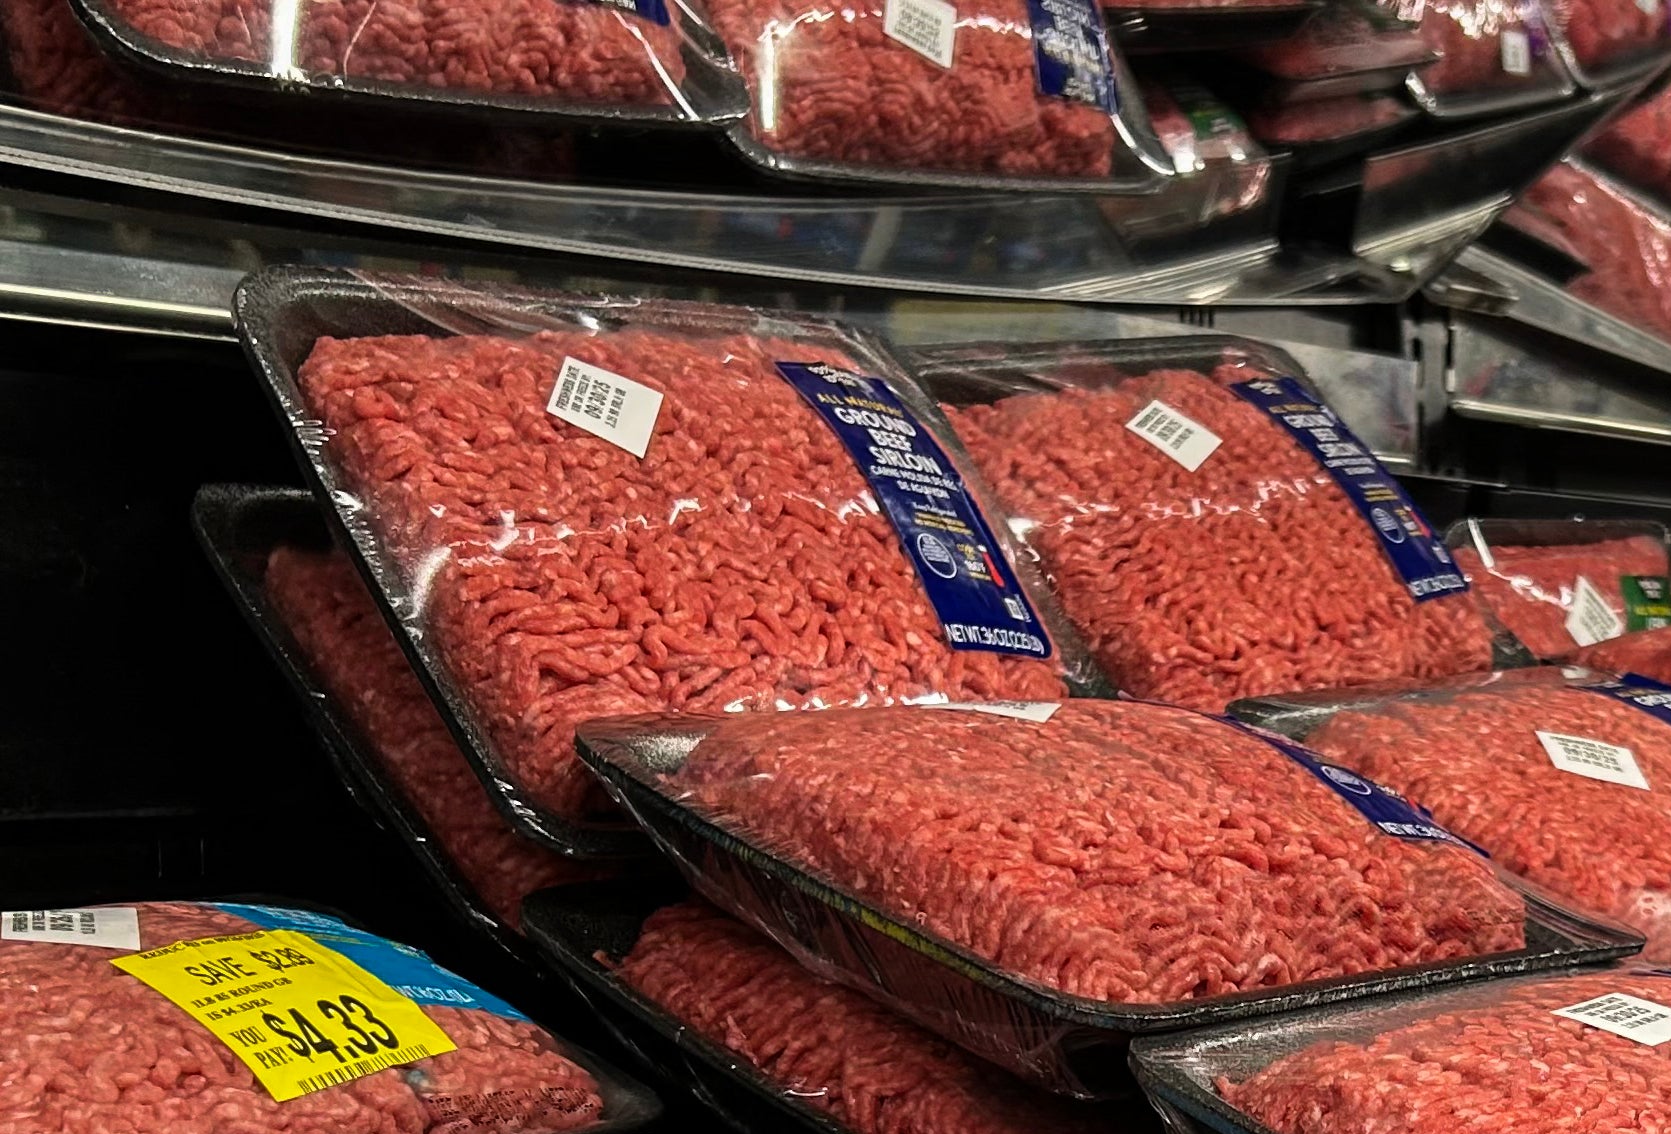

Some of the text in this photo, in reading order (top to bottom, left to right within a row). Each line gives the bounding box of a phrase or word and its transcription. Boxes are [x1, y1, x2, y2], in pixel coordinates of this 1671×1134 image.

[834, 407, 917, 437] GROUND
[867, 429, 913, 452] BEEF
[869, 446, 943, 476] SIRLOIN
[184, 957, 257, 986] SAVE
[228, 981, 275, 998] ROUND
[230, 1026, 268, 1047] YOU
[261, 994, 401, 1065] $4.33
[254, 1046, 295, 1069] PAY!
